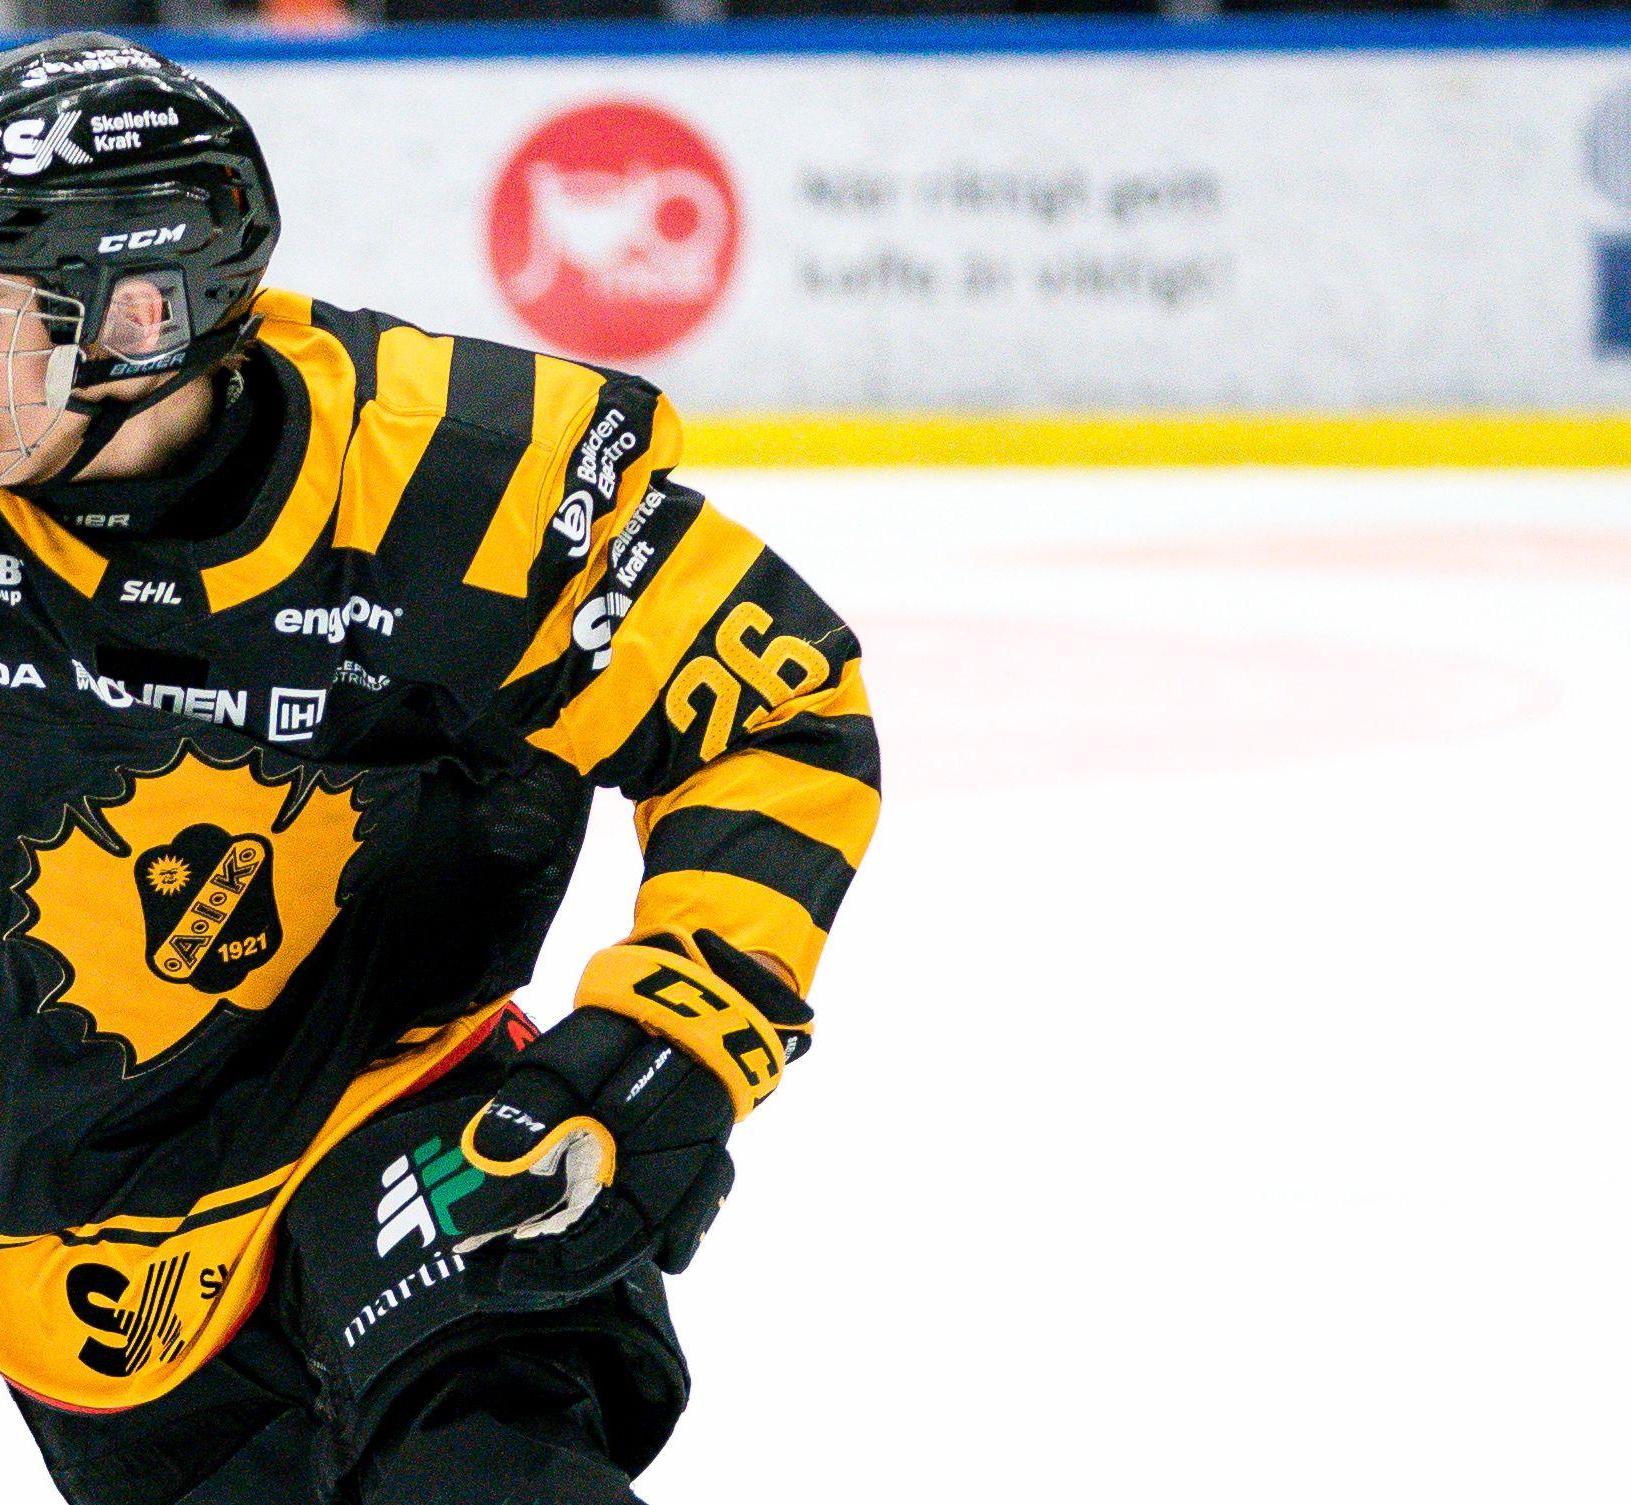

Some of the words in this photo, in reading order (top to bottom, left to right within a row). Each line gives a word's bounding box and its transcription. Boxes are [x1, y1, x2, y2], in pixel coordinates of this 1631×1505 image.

[89, 106, 180, 133] Skellefteå
[93, 131, 142, 152] Kraft
[98, 223, 186, 254] CCM
[576, 408, 626, 485] Boliden
[119, 580, 182, 604] SHL
[666, 602, 830, 762] 26
[218, 932, 268, 963] 1921
